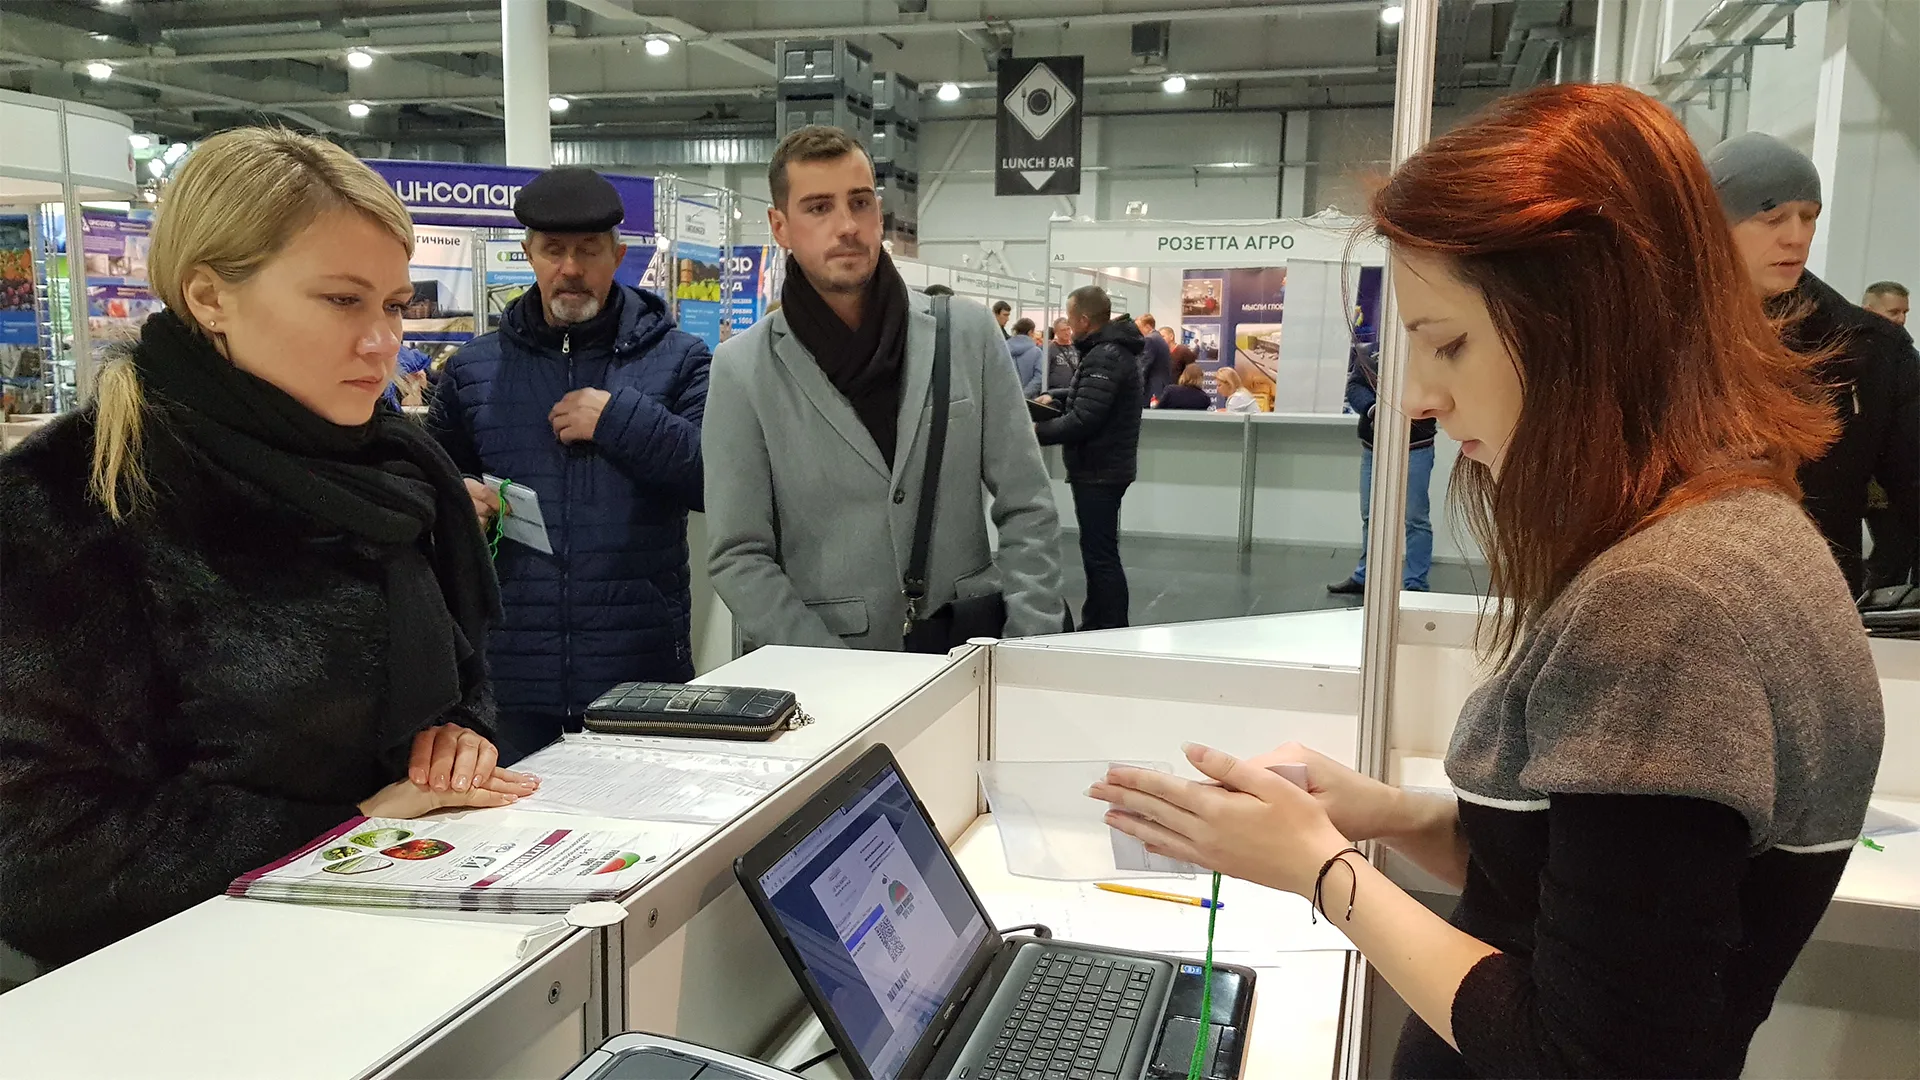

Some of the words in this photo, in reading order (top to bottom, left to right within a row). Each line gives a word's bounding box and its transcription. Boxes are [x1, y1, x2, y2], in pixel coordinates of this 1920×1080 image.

[1002, 157, 1045, 169] LUNCH
[1048, 156, 1075, 168] BAR
[1158, 236, 1239, 251] РОЗЕТТА
[1244, 235, 1295, 250] АГРО
[1242, 303, 1267, 311] МЫСЛИ
